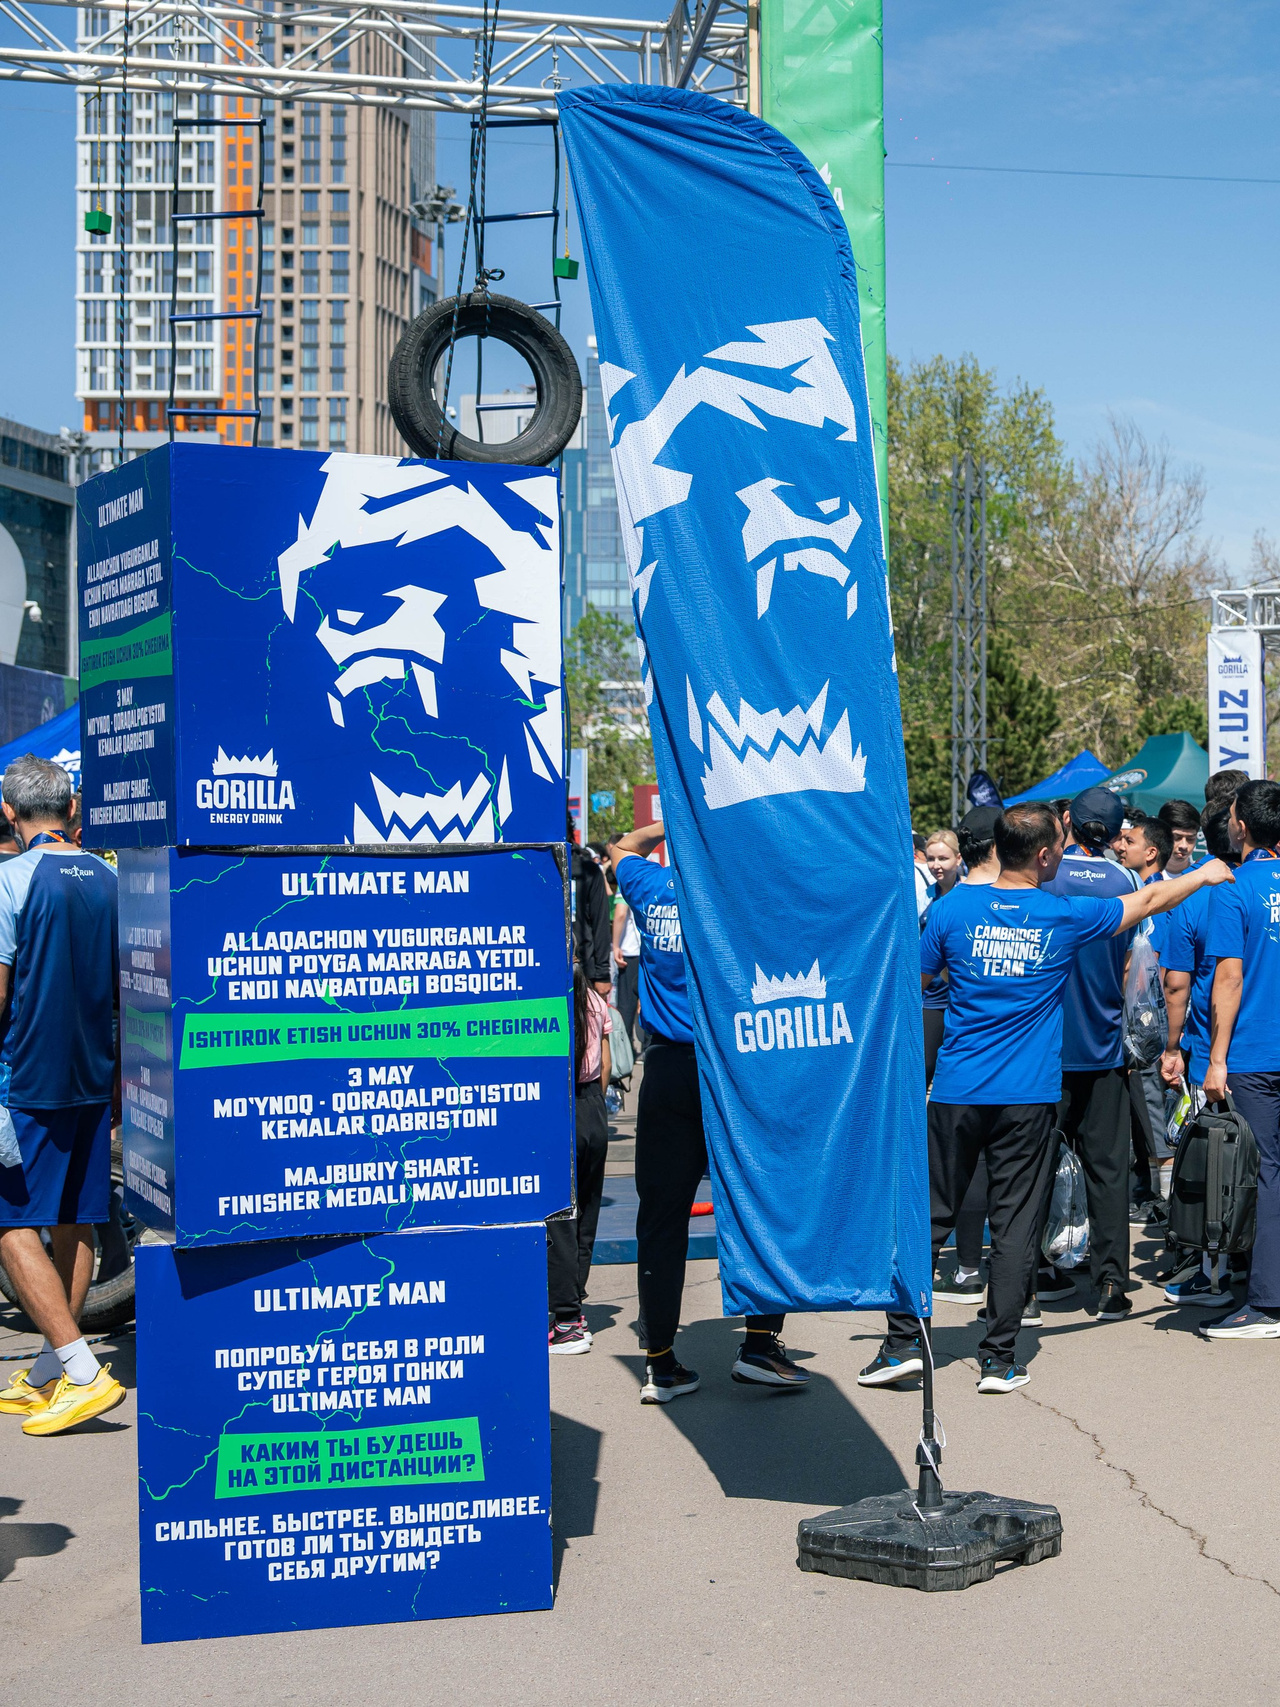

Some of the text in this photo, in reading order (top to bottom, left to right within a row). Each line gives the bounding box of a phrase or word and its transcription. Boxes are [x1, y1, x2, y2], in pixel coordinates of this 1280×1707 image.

[99, 487, 143, 528] ULTIMATE MAN
[1218, 665, 1248, 674] GORILLA
[117, 686, 133, 707] 3 MAY
[1219, 689, 1249, 775] Y.UZ
[196, 780, 295, 810] GORILLA
[210, 813, 282, 824] ENERGY DRINK
[60, 867, 94, 877] PRO RUN
[282, 871, 469, 895] ULTIMATE MAN
[647, 904, 678, 918] CAMB
[223, 926, 526, 952] ALLAQACHON YUGURGANLAR
[974, 925, 1042, 942] CAMBRIDGE
[208, 949, 540, 976] UCHUN POYGA MARRAGA YETDI.
[972, 940, 1040, 960] RUNNING
[983, 959, 1025, 976] TEAM
[229, 972, 522, 1000] ENDI NAVBATDAGI BOSQICH.
[189, 1017, 560, 1048] ISHTIROK ETISH UCHUN 30% CHEGIRMA
[734, 1002, 853, 1053] GORILLA
[349, 1065, 414, 1086] 3 MAY
[262, 1108, 497, 1140] KEMALAR QABRISTONI
[285, 1156, 478, 1187] MAJBURIY SHART:
[219, 1175, 539, 1216] FINISHER MEDALI MAVJUDLIGI
[254, 1281, 445, 1312] ULTIMATE MAN
[216, 1335, 484, 1368] ПОПРОБУЙ СЕБЯ В РОЛИ
[238, 1360, 463, 1391] СУПЕР ГЕРОЯ ГОНКИ
[273, 1386, 430, 1413] ULTIMATE MAN
[242, 1432, 462, 1464] КАКИМ ТЫ БУДЕШЬ
[229, 1454, 475, 1488] НА ЭТОЙ ДИСТАНЦИИ?
[156, 1496, 545, 1541] СИЛЬНЕЕ. БЫСТРЕЕ. ВЫНОСЛИВЕЕ.
[225, 1524, 481, 1560] ГОТОВ ЛИ ТЫ УВИДЕТЬ
[269, 1551, 440, 1581] СЕБЯ ДРУГИМ?
